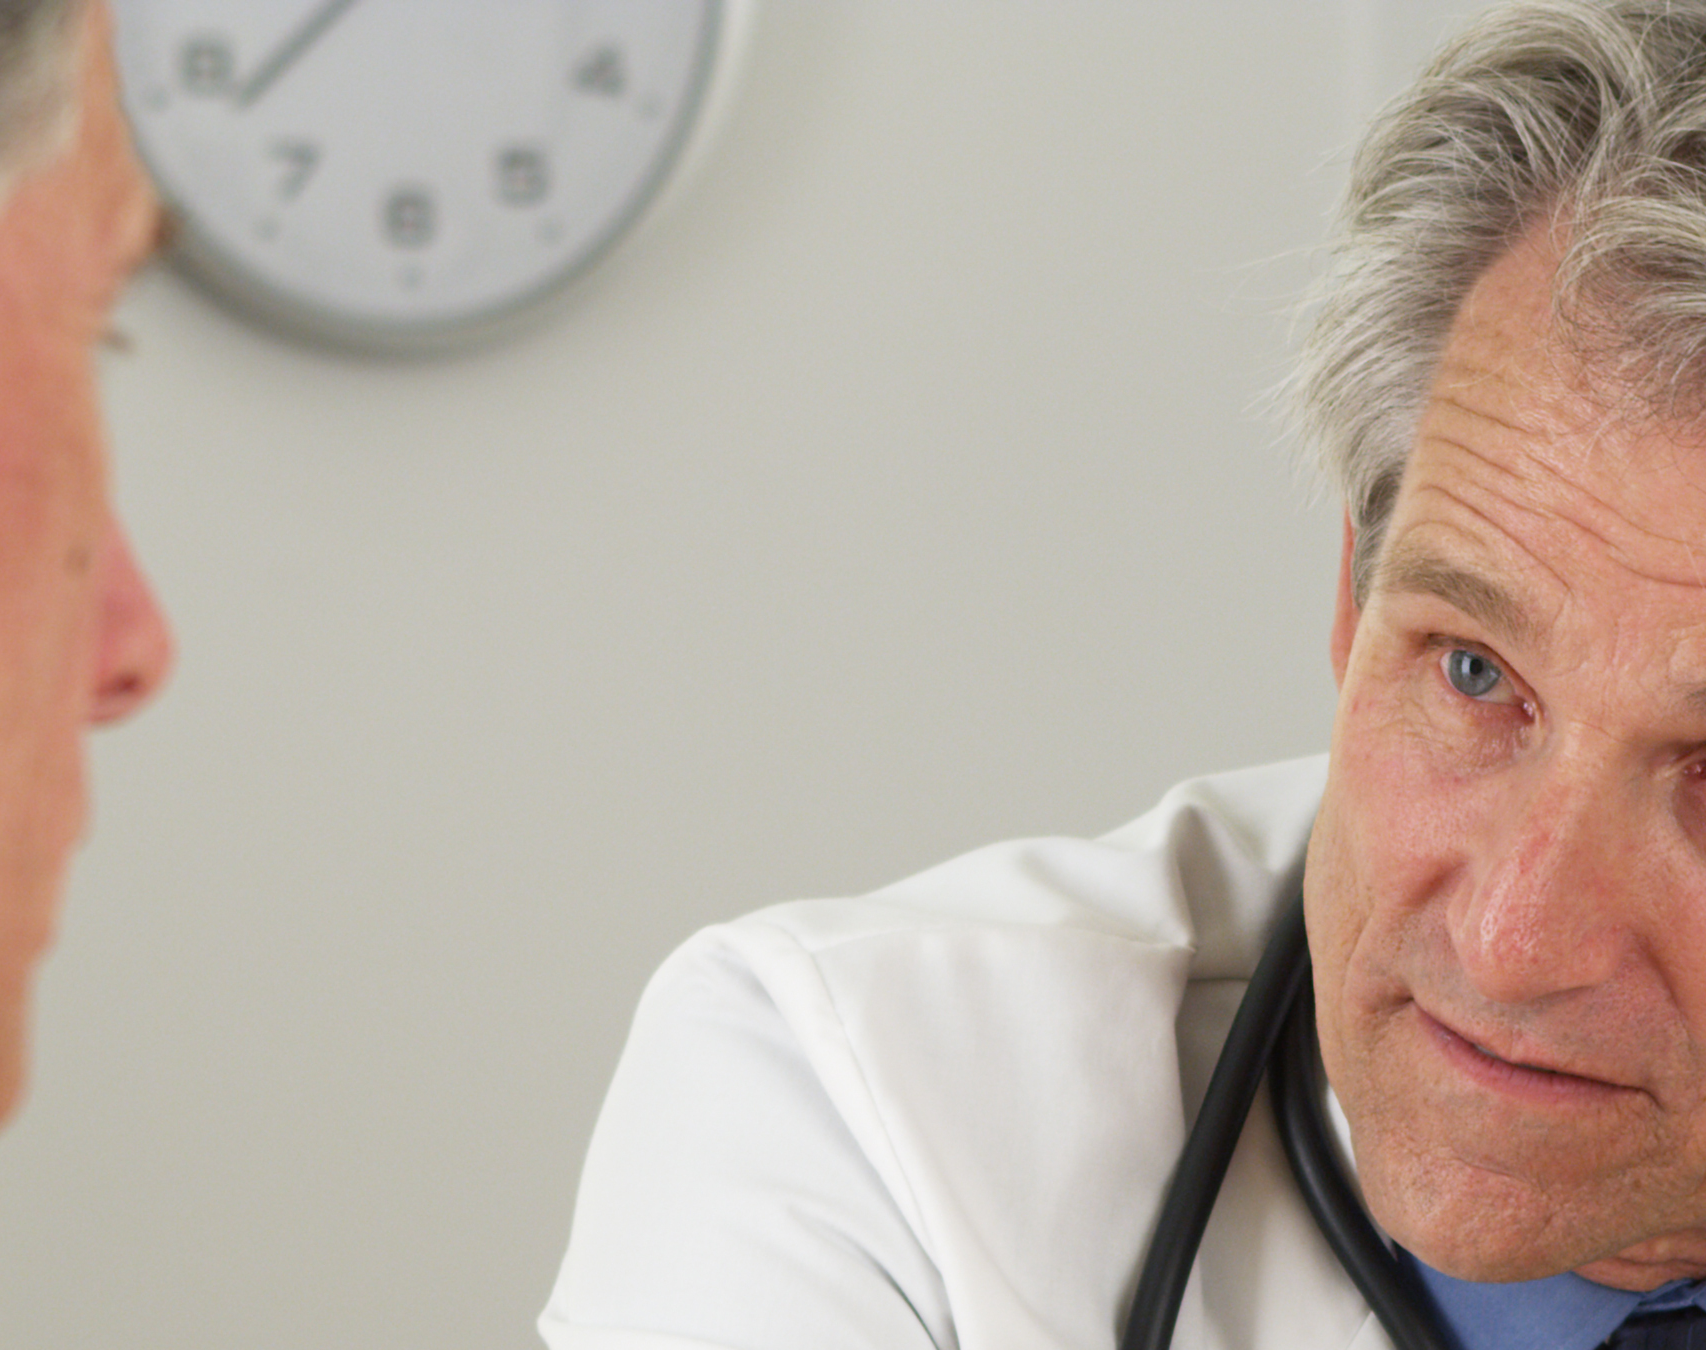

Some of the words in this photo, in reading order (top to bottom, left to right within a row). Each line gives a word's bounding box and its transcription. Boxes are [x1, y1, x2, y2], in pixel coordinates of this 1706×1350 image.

[571, 45, 628, 98] 4
[267, 138, 322, 202] 7
[494, 143, 548, 206] 5
[381, 184, 436, 249] 6
